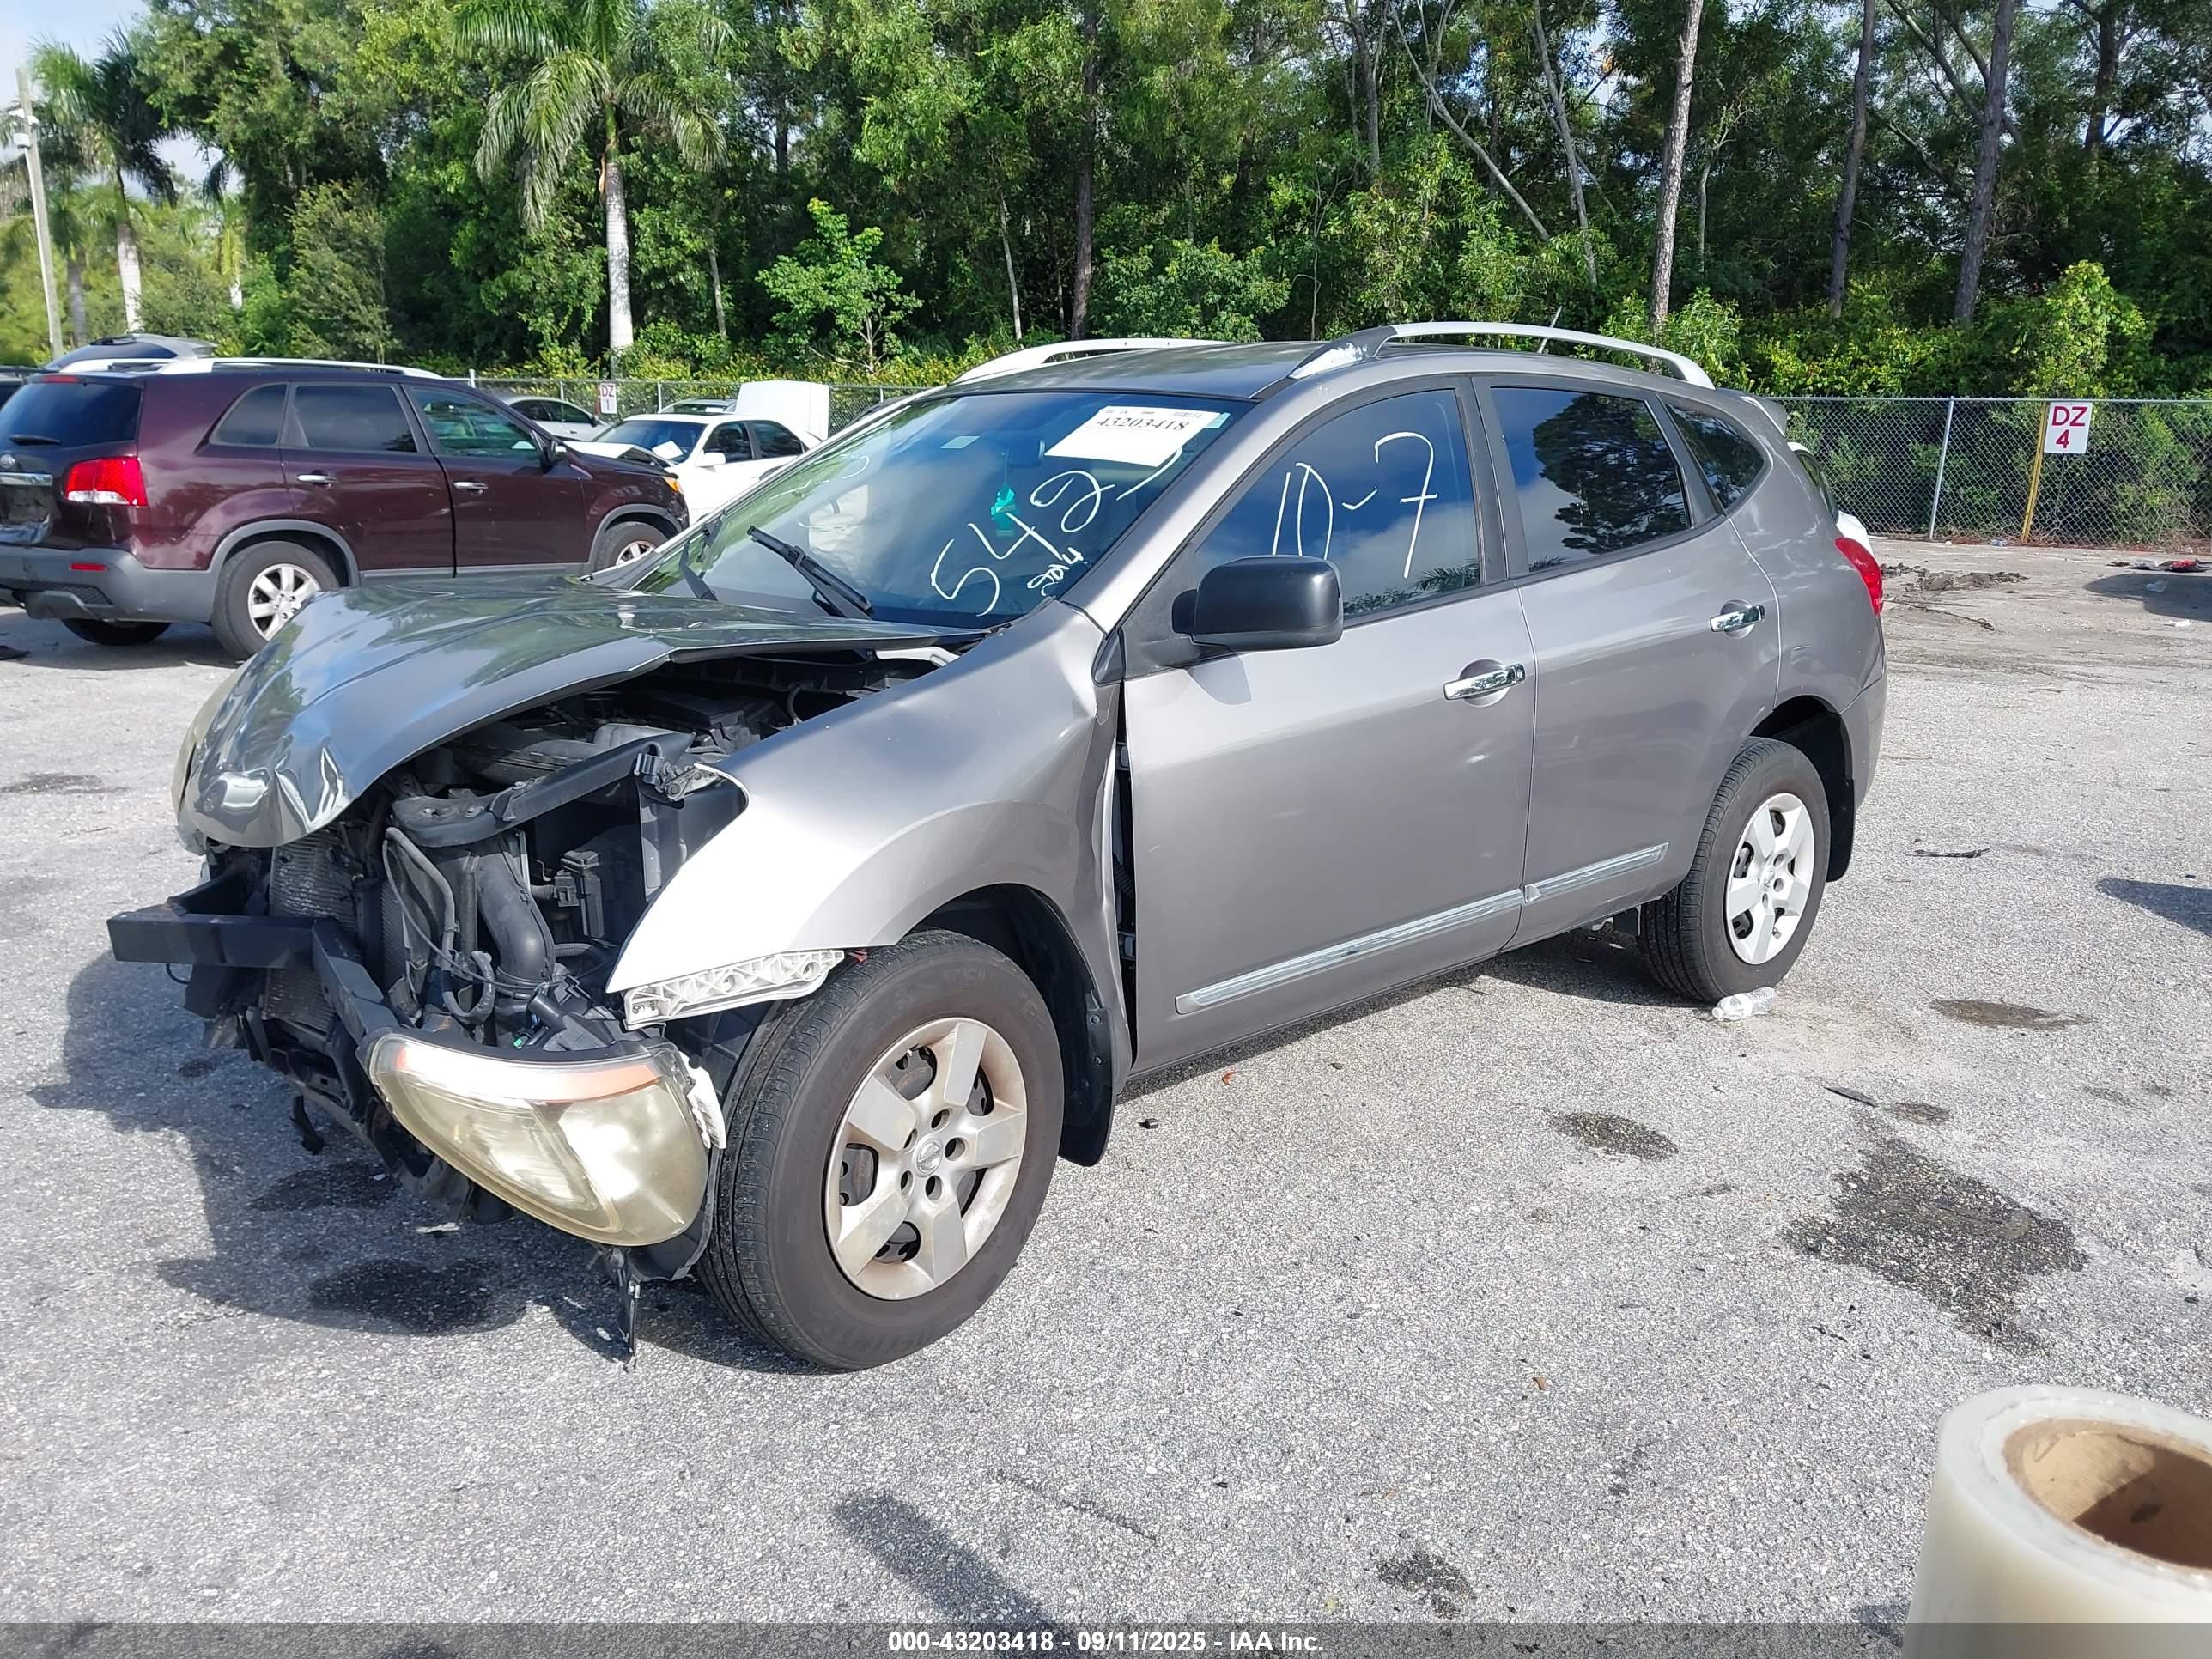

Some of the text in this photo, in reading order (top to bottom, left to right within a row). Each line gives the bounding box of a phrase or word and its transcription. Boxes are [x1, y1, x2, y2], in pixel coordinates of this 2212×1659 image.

[601, 384, 615, 398] DZ
[1096, 416, 1190, 431] 43203418
[2051, 405, 2088, 427] DZ
[2056, 429, 2070, 449] 4
